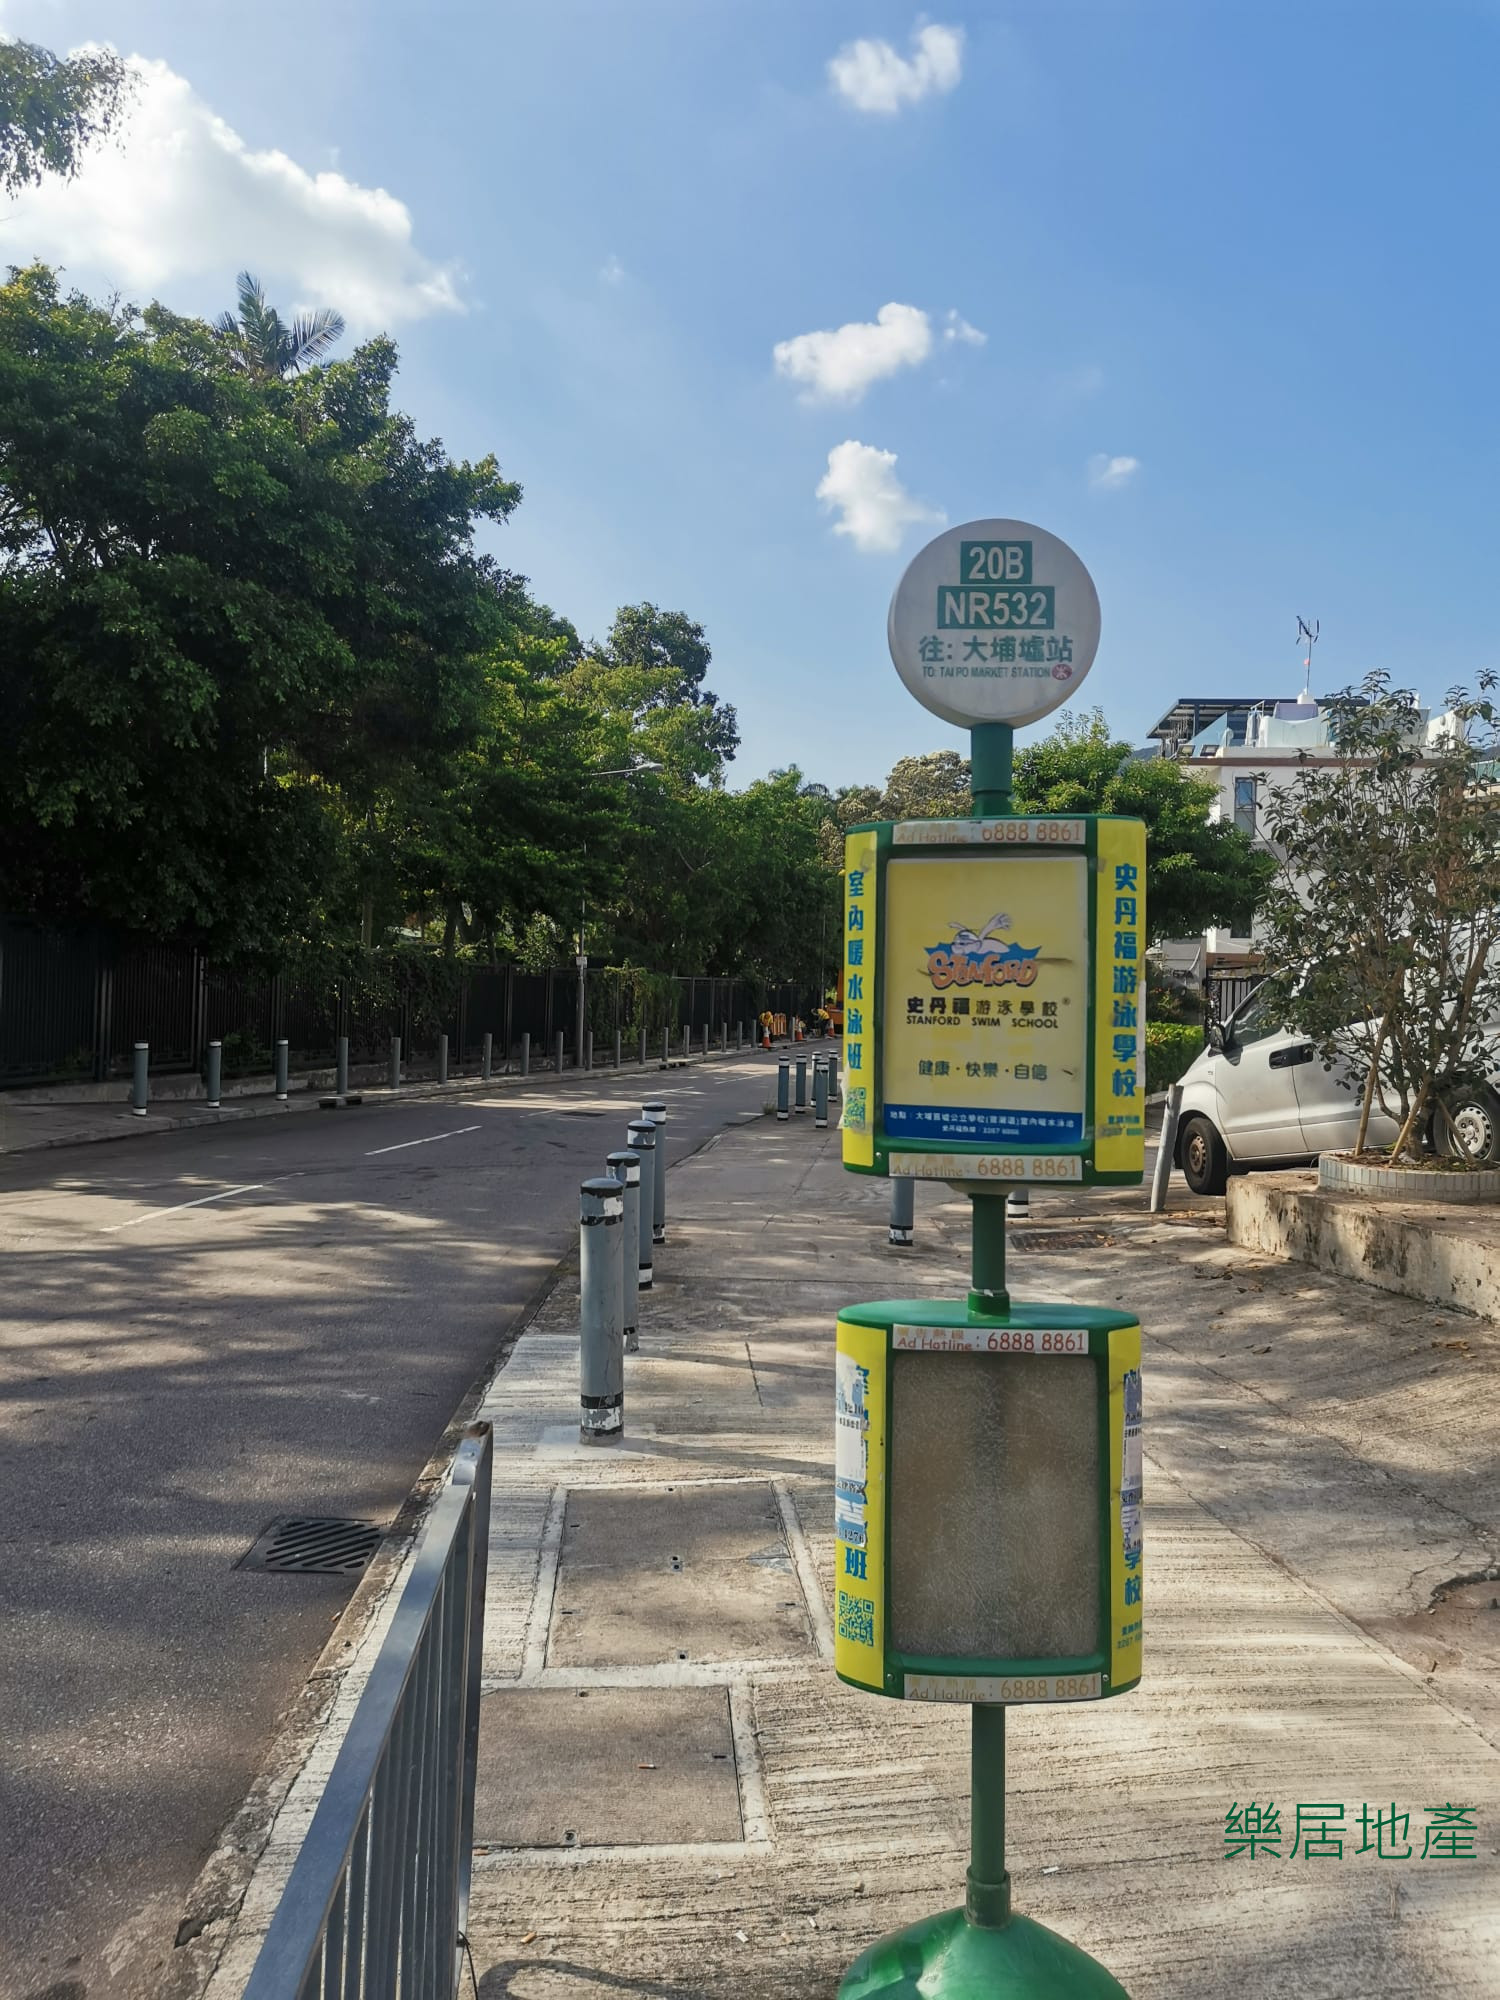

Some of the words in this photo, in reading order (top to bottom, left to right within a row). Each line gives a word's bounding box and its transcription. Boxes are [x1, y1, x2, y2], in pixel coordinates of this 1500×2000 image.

[968, 546, 1024, 580] 20B
[944, 591, 1048, 625] NR532
[940, 666, 955, 678] TAI
[956, 666, 969, 678] PO
[971, 666, 1009, 678] MARKET
[1011, 666, 1050, 678] STATION
[981, 822, 1029, 841] 6888
[1036, 822, 1081, 841] 8861
[1112, 863, 1137, 1098] 史丹福游泳學校
[906, 1016, 961, 1026] STANFORD
[971, 1017, 1001, 1027] SWIM
[1011, 1018, 1059, 1028] SCHOOL
[977, 1158, 1025, 1176] 6888
[1032, 1158, 1077, 1177] 8861
[897, 1336, 916, 1349] Ad
[987, 1332, 1035, 1351] 6888
[1041, 1332, 1085, 1351] 8861
[1000, 1680, 1048, 1699] 6888
[1055, 1675, 1097, 1698] 8861
